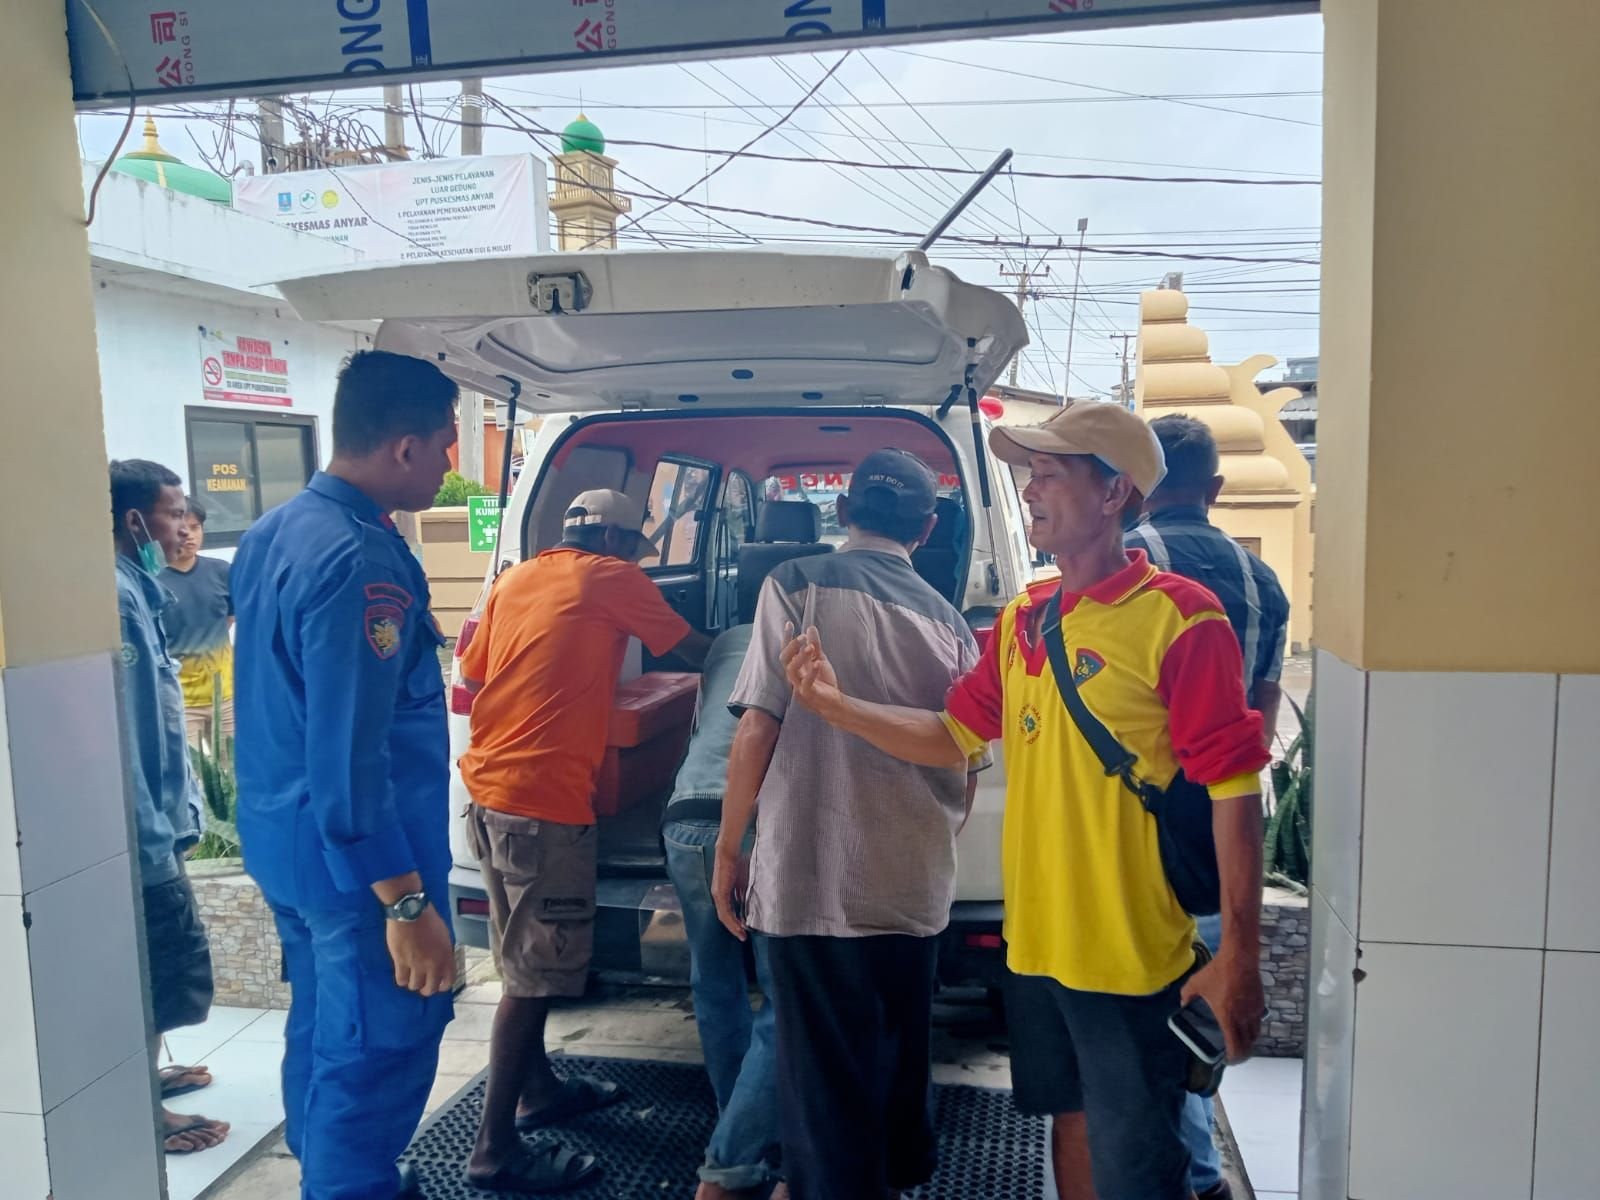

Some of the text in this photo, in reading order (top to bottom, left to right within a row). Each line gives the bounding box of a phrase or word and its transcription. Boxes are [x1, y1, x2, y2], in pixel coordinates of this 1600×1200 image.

[179, 11, 195, 85] GONG SI
[430, 183, 477, 194] LUAR GEDUNG
[471, 192, 494, 201] ANYAR
[333, 217, 368, 228] ANYAR
[212, 464, 238, 475] POS
